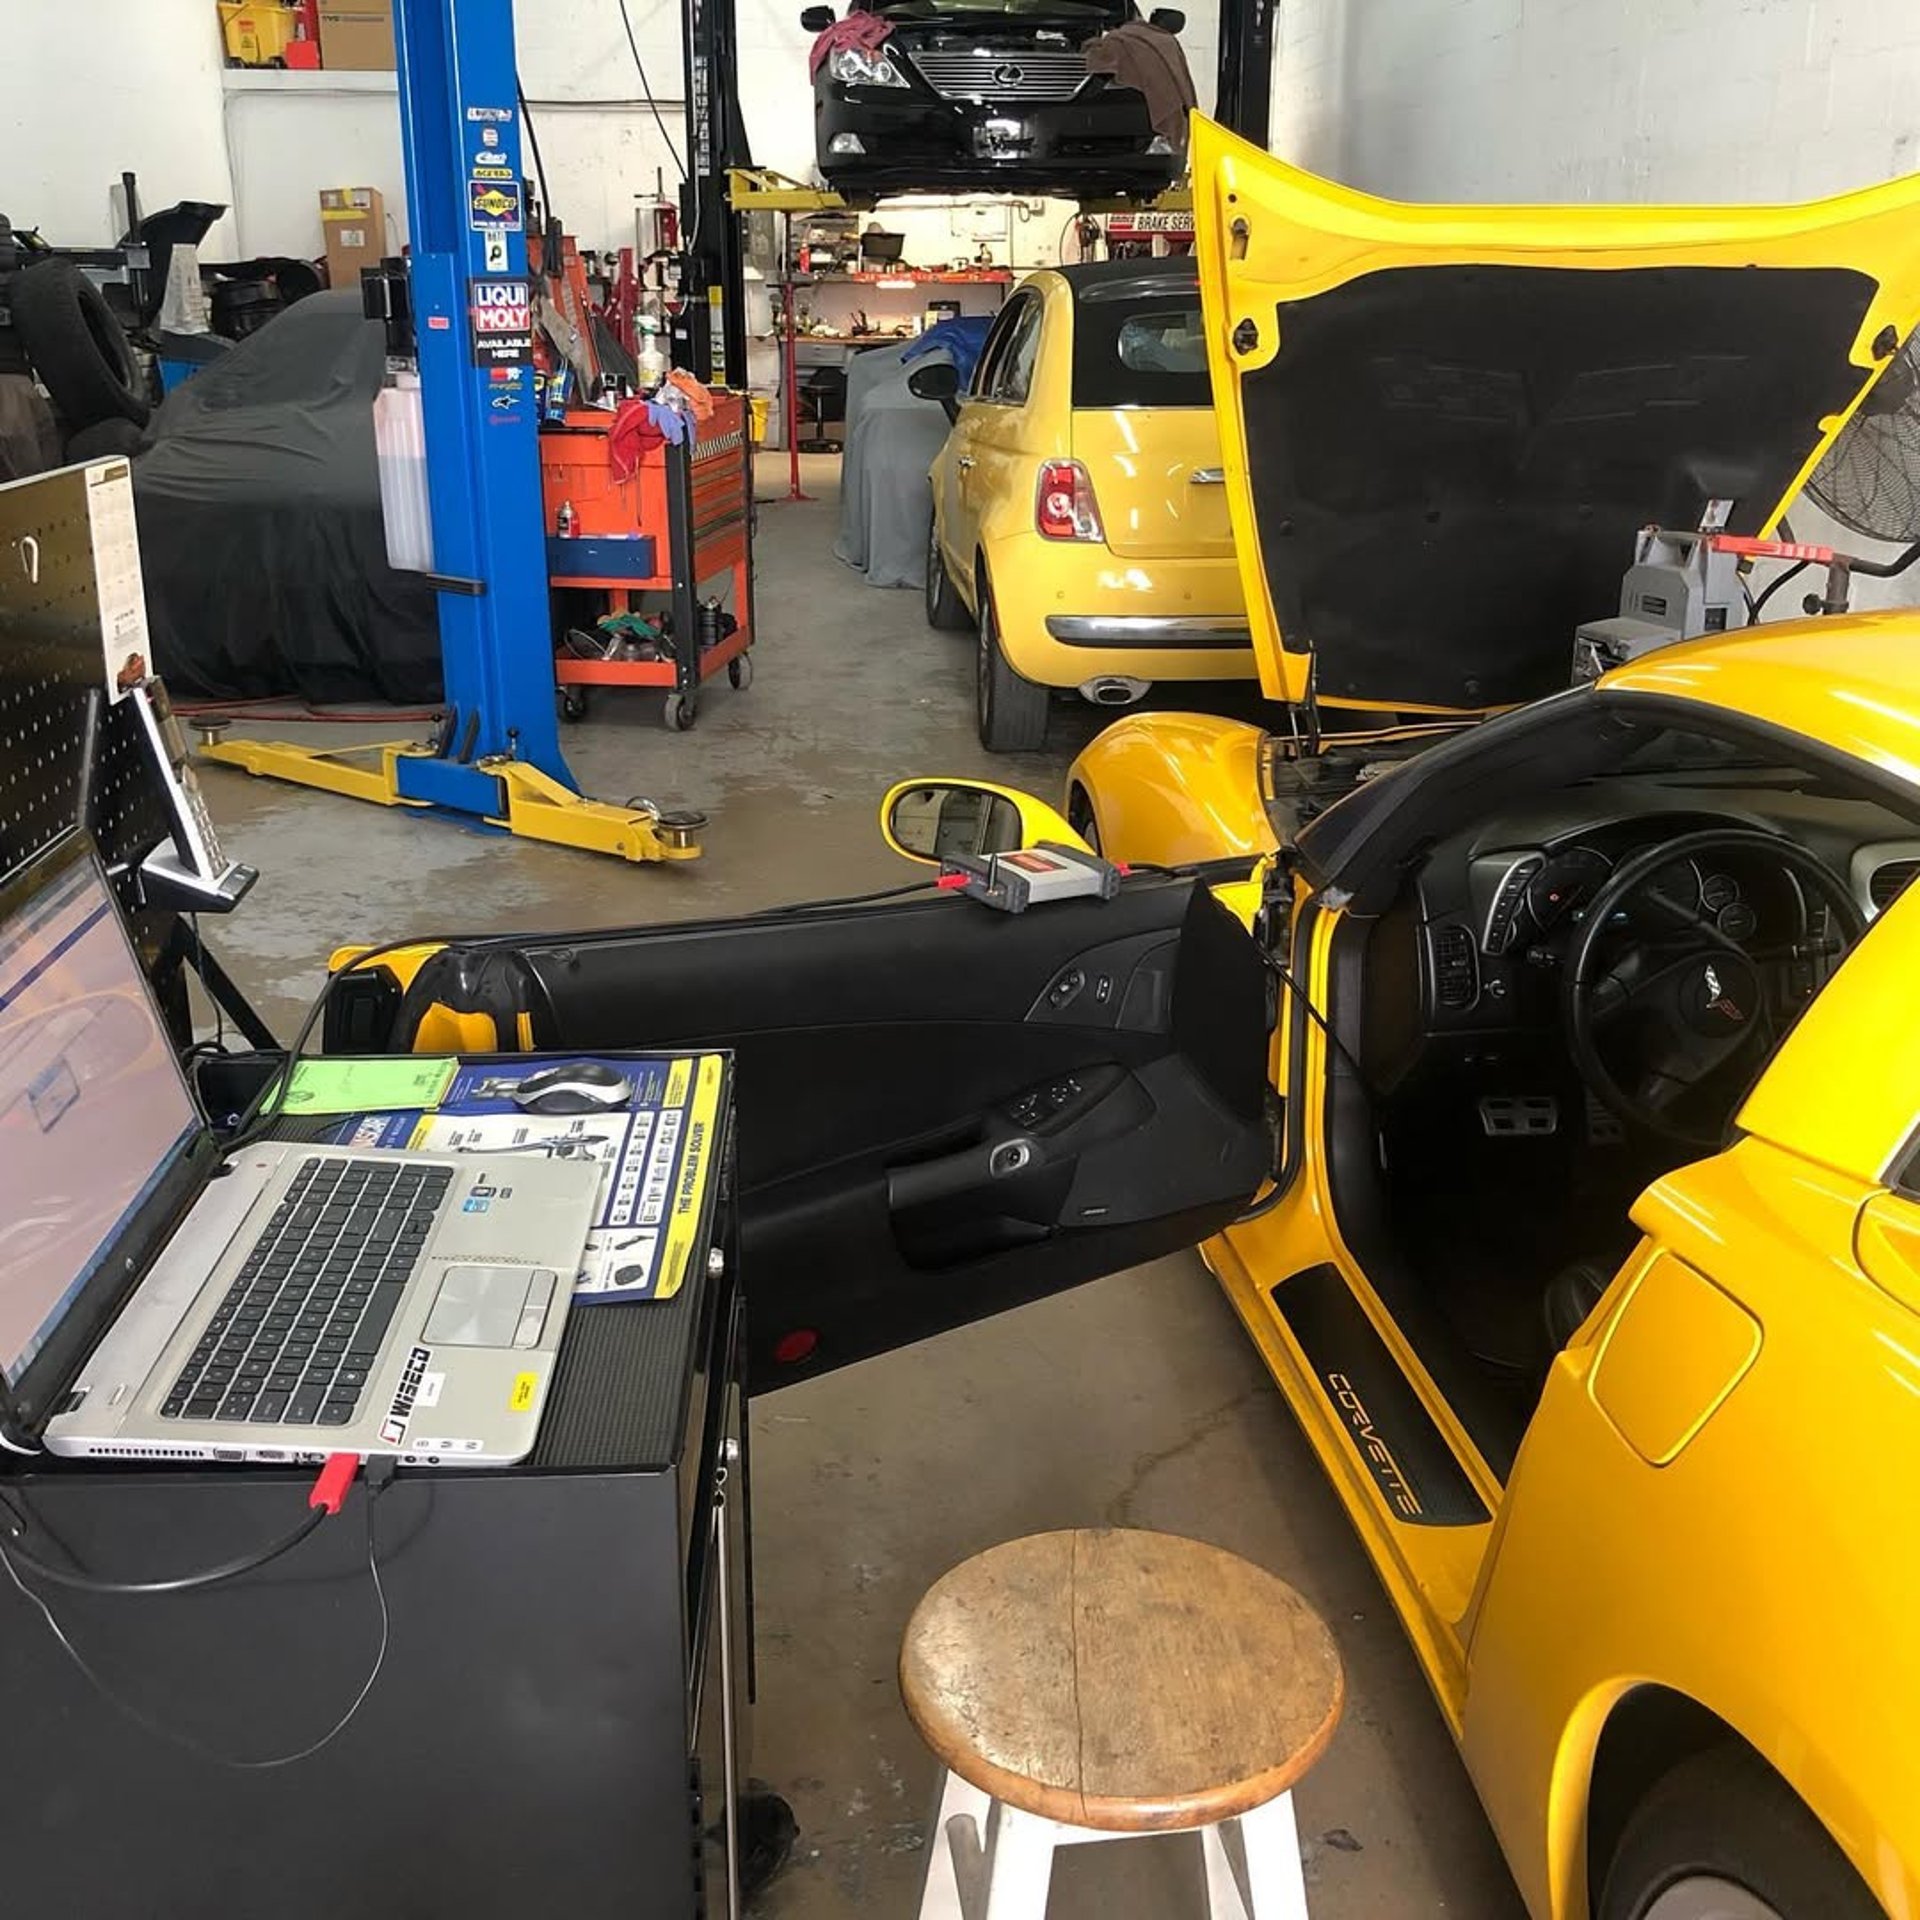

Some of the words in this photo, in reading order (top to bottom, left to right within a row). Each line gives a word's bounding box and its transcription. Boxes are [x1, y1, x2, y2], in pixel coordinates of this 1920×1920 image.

[474, 198, 515, 209] SUNOCO
[1137, 216, 1169, 230] BRAKE
[477, 286, 525, 307] LIQUI
[479, 308, 528, 328] MOLY
[477, 338, 532, 349] AVAILABLE
[491, 349, 520, 358] HERE
[689, 1121, 705, 1152] SOLVER
[682, 1155, 699, 1195] PROBLEM
[677, 1197, 692, 1214] THE
[1328, 1373, 1423, 1515] CORVETTE
